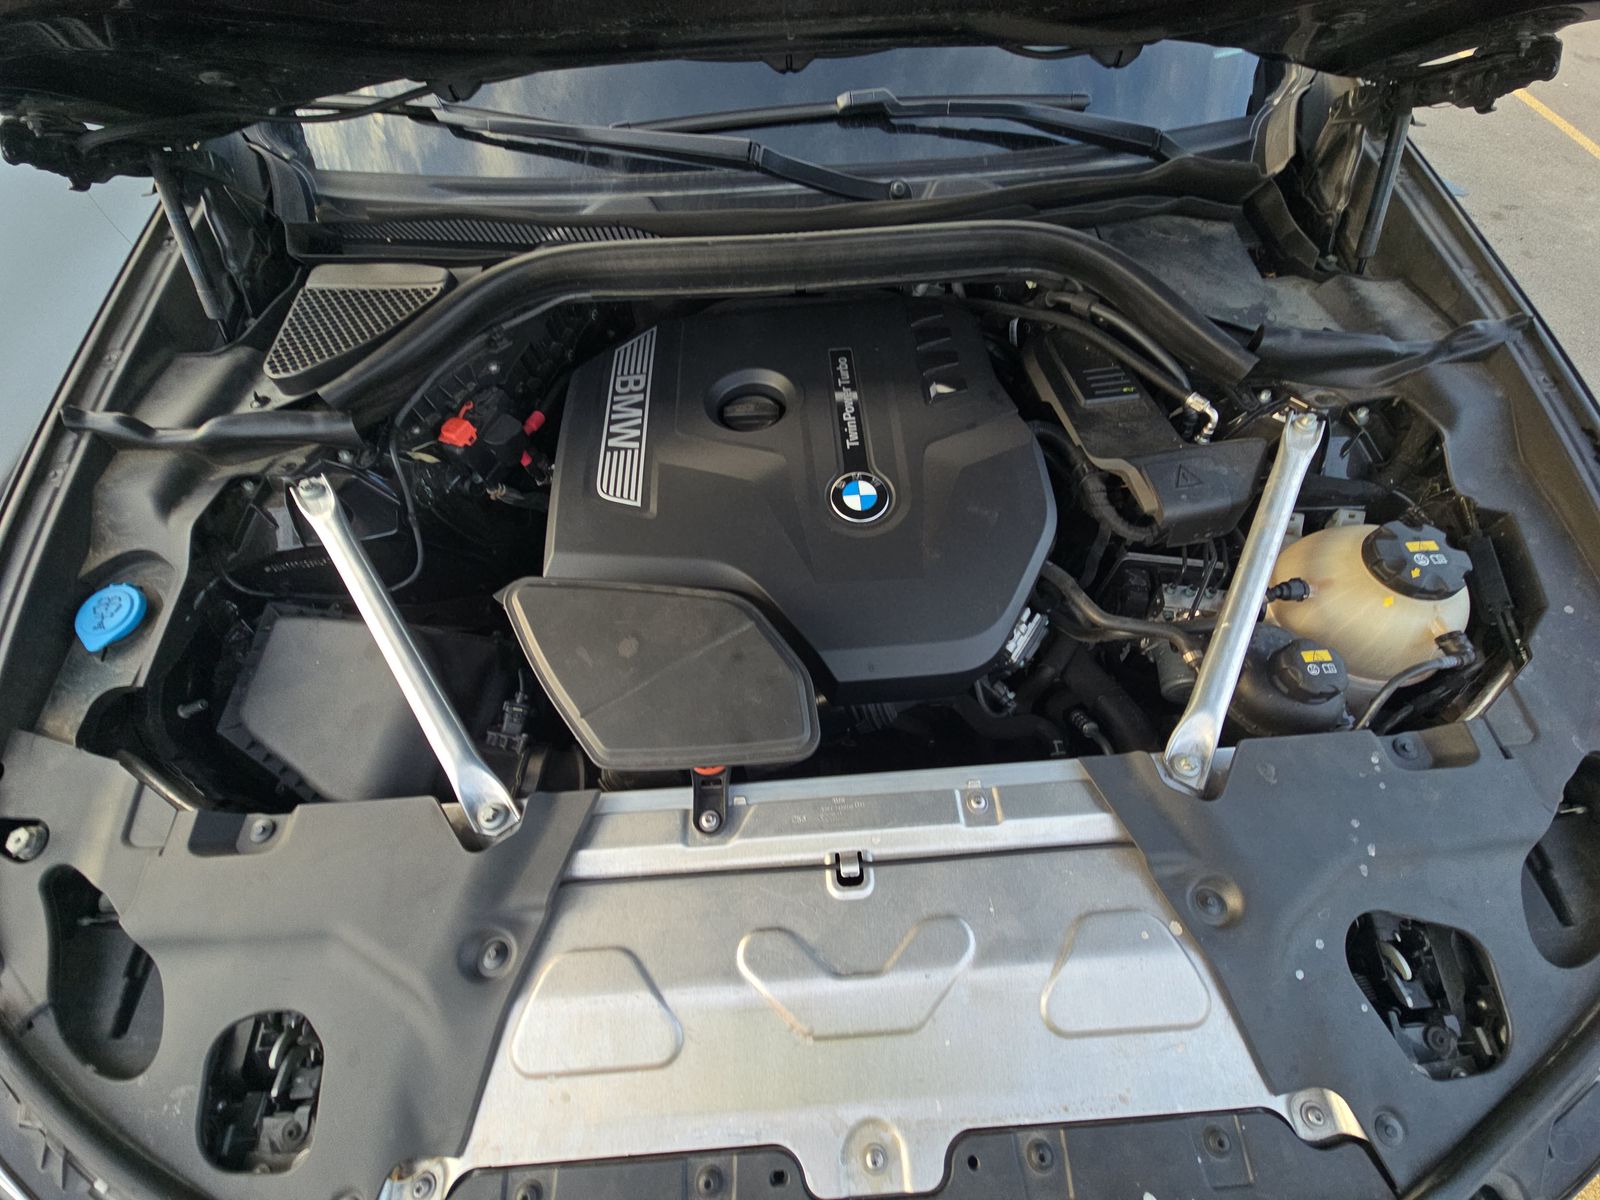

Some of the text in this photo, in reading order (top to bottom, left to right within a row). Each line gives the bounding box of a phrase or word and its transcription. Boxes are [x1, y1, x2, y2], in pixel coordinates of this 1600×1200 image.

[608, 373, 646, 449] BMW
[837, 356, 860, 450] TwinPower Turbo
